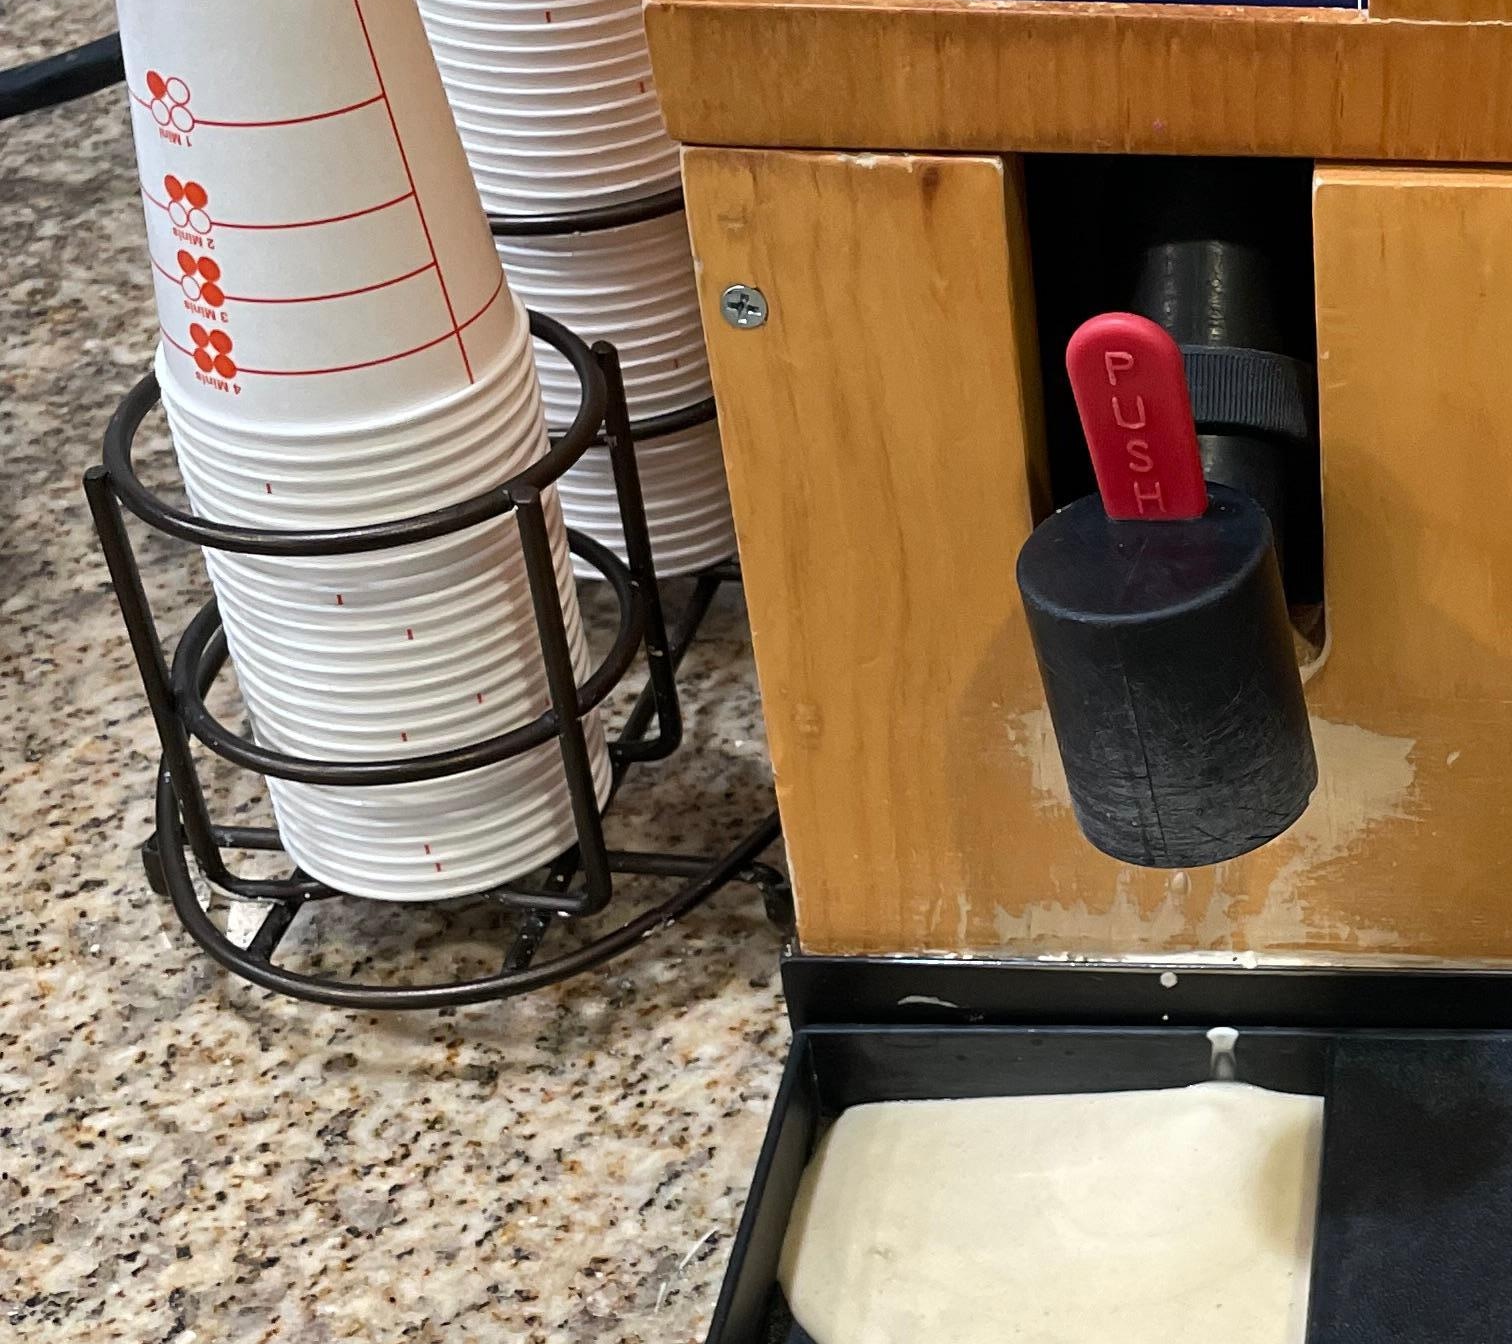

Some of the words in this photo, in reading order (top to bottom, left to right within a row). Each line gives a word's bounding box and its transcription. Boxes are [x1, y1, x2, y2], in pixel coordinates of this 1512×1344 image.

[159, 128, 182, 146] Mini
[172, 227, 203, 248] Minis
[206, 237, 215, 249] 2
[184, 300, 216, 321] Minis
[220, 312, 229, 323] 3
[195, 371, 229, 393] Minis
[233, 384, 241, 395] 4
[1104, 351, 1167, 514] PUSH
